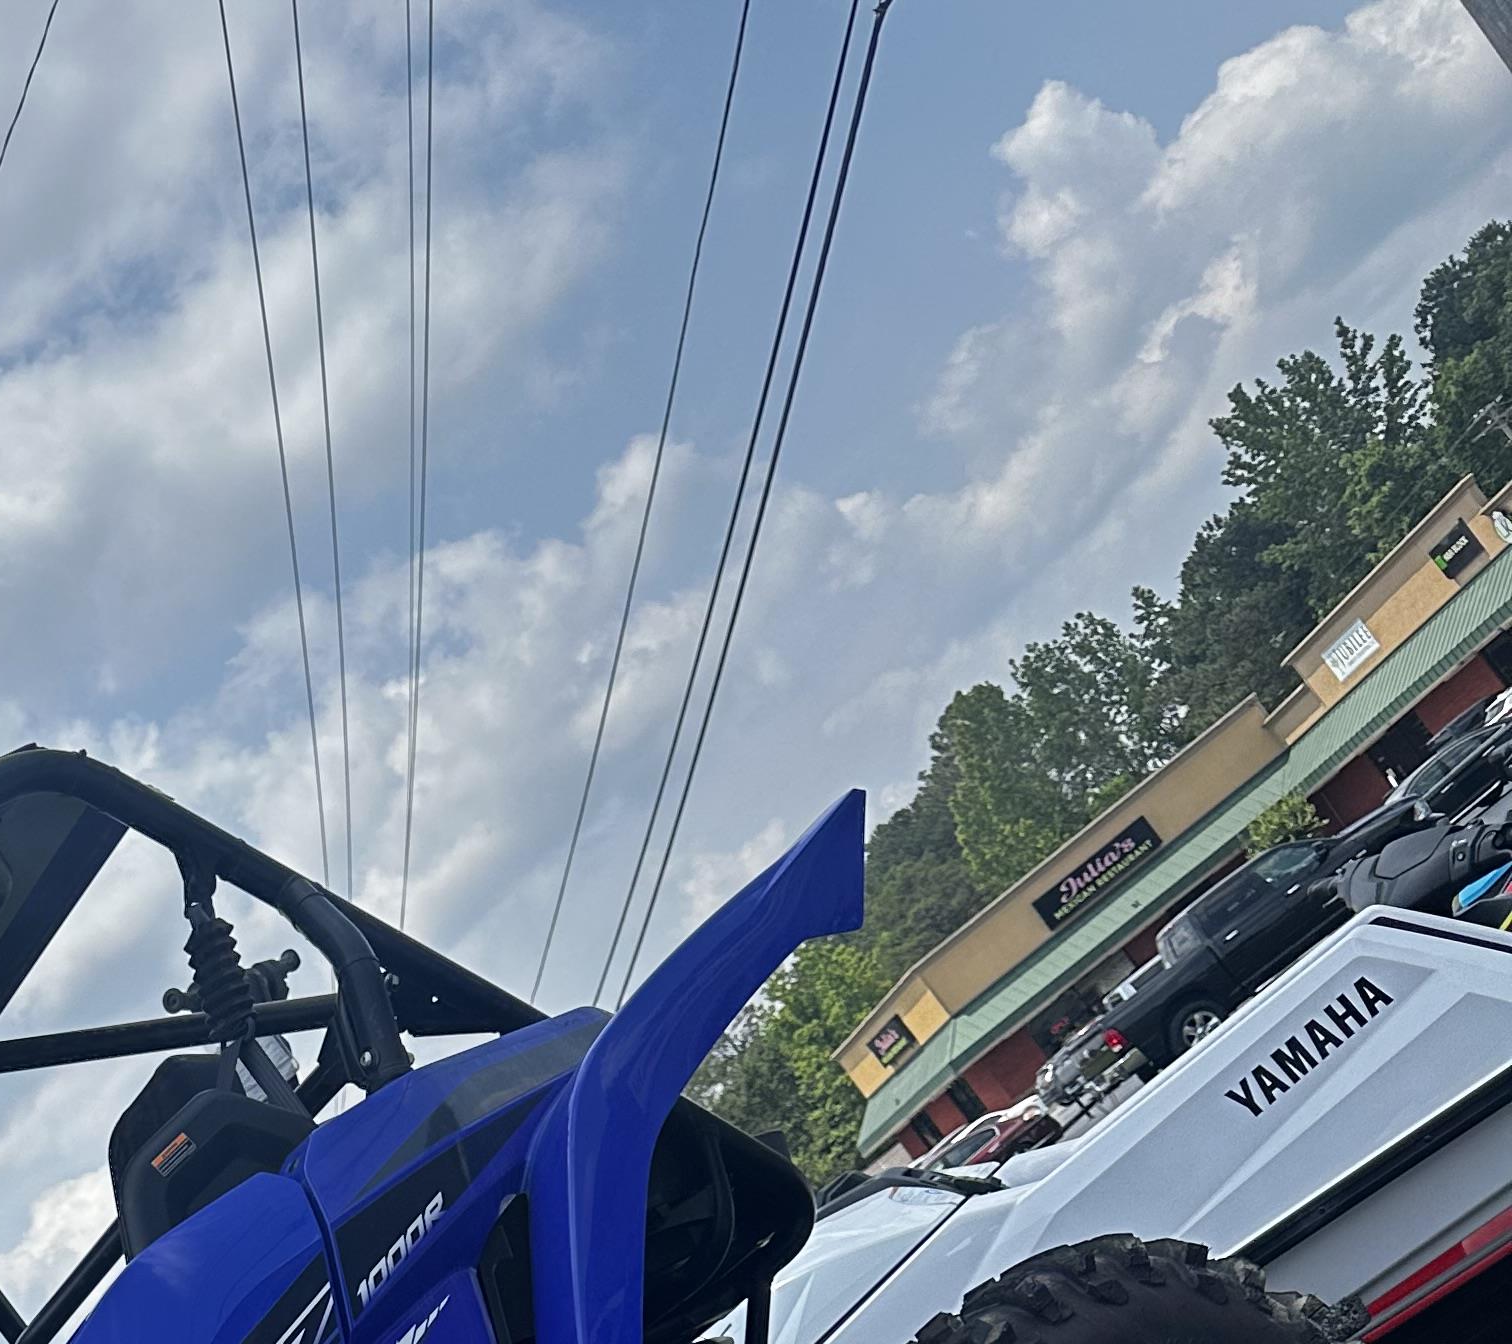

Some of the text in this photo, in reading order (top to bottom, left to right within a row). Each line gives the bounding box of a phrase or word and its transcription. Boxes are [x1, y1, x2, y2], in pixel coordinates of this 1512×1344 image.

[1332, 625, 1372, 668] JUBILEE
[1053, 839, 1153, 920] MEXICAN RESTAURANT
[1059, 837, 1136, 903] Julia's
[1224, 976, 1394, 1118] YAMAHA
[356, 1191, 445, 1307] 1000R
